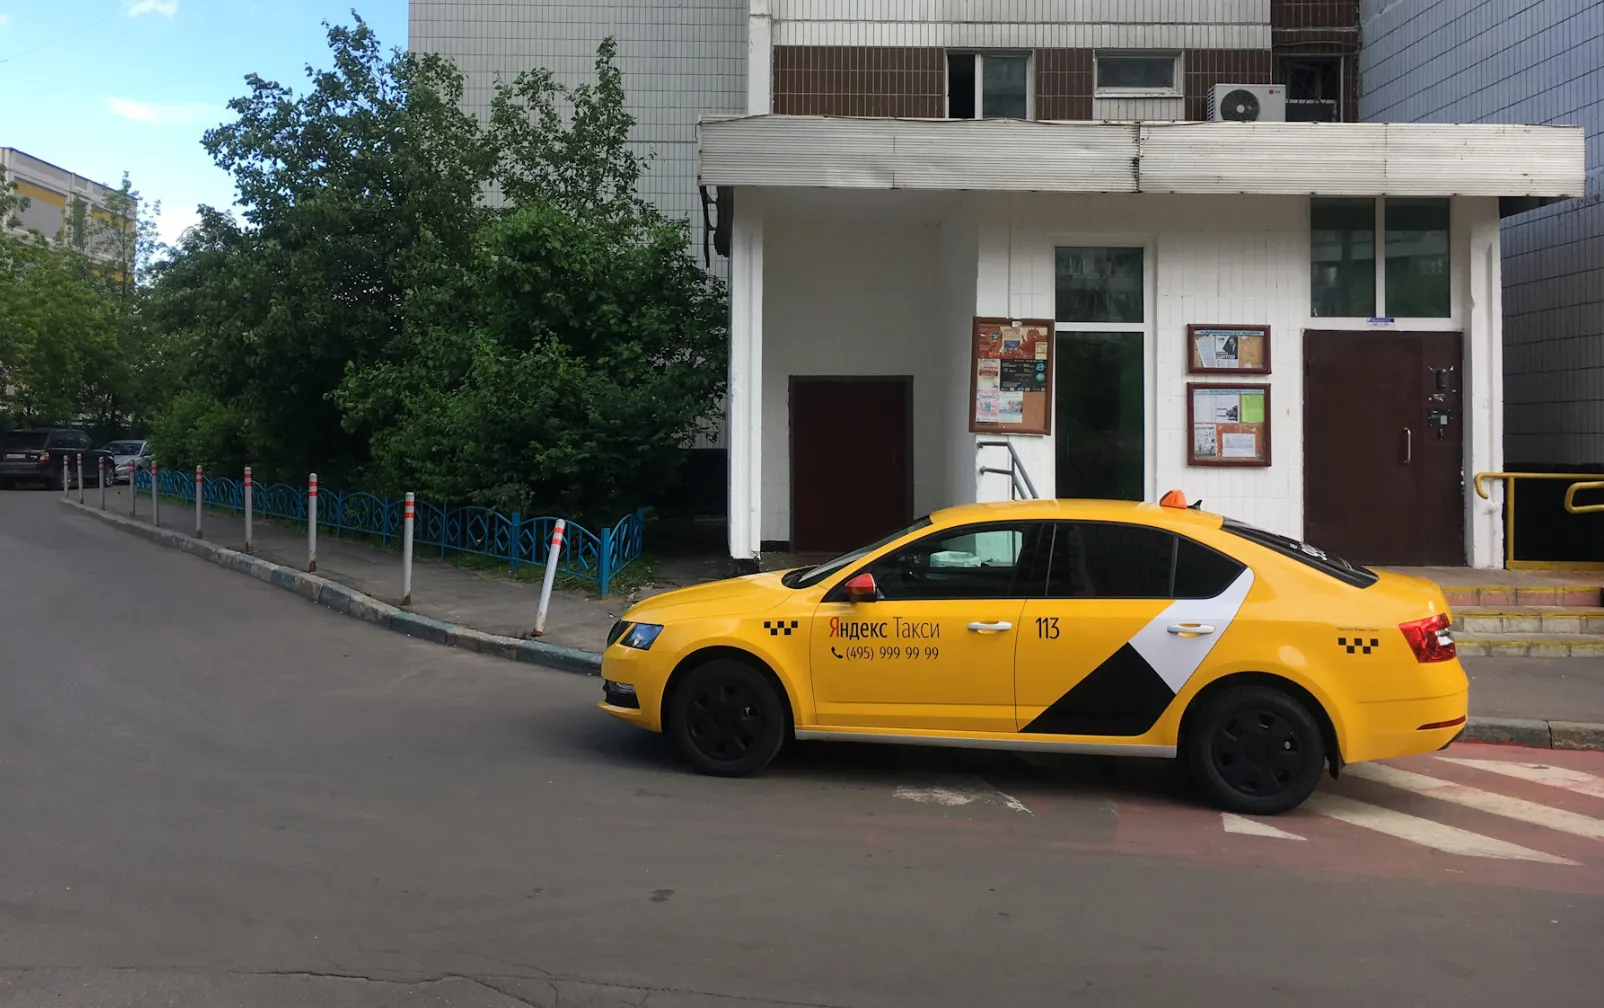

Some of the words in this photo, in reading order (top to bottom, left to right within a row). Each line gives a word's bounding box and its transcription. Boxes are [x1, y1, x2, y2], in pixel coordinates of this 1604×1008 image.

[829, 616, 888, 640] Яндекс
[893, 616, 940, 639] Такси
[1035, 617, 1060, 640] 113
[846, 646, 875, 661] (495)
[879, 646, 901, 660] 999
[905, 646, 920, 660] 99
[924, 646, 939, 660] 99
